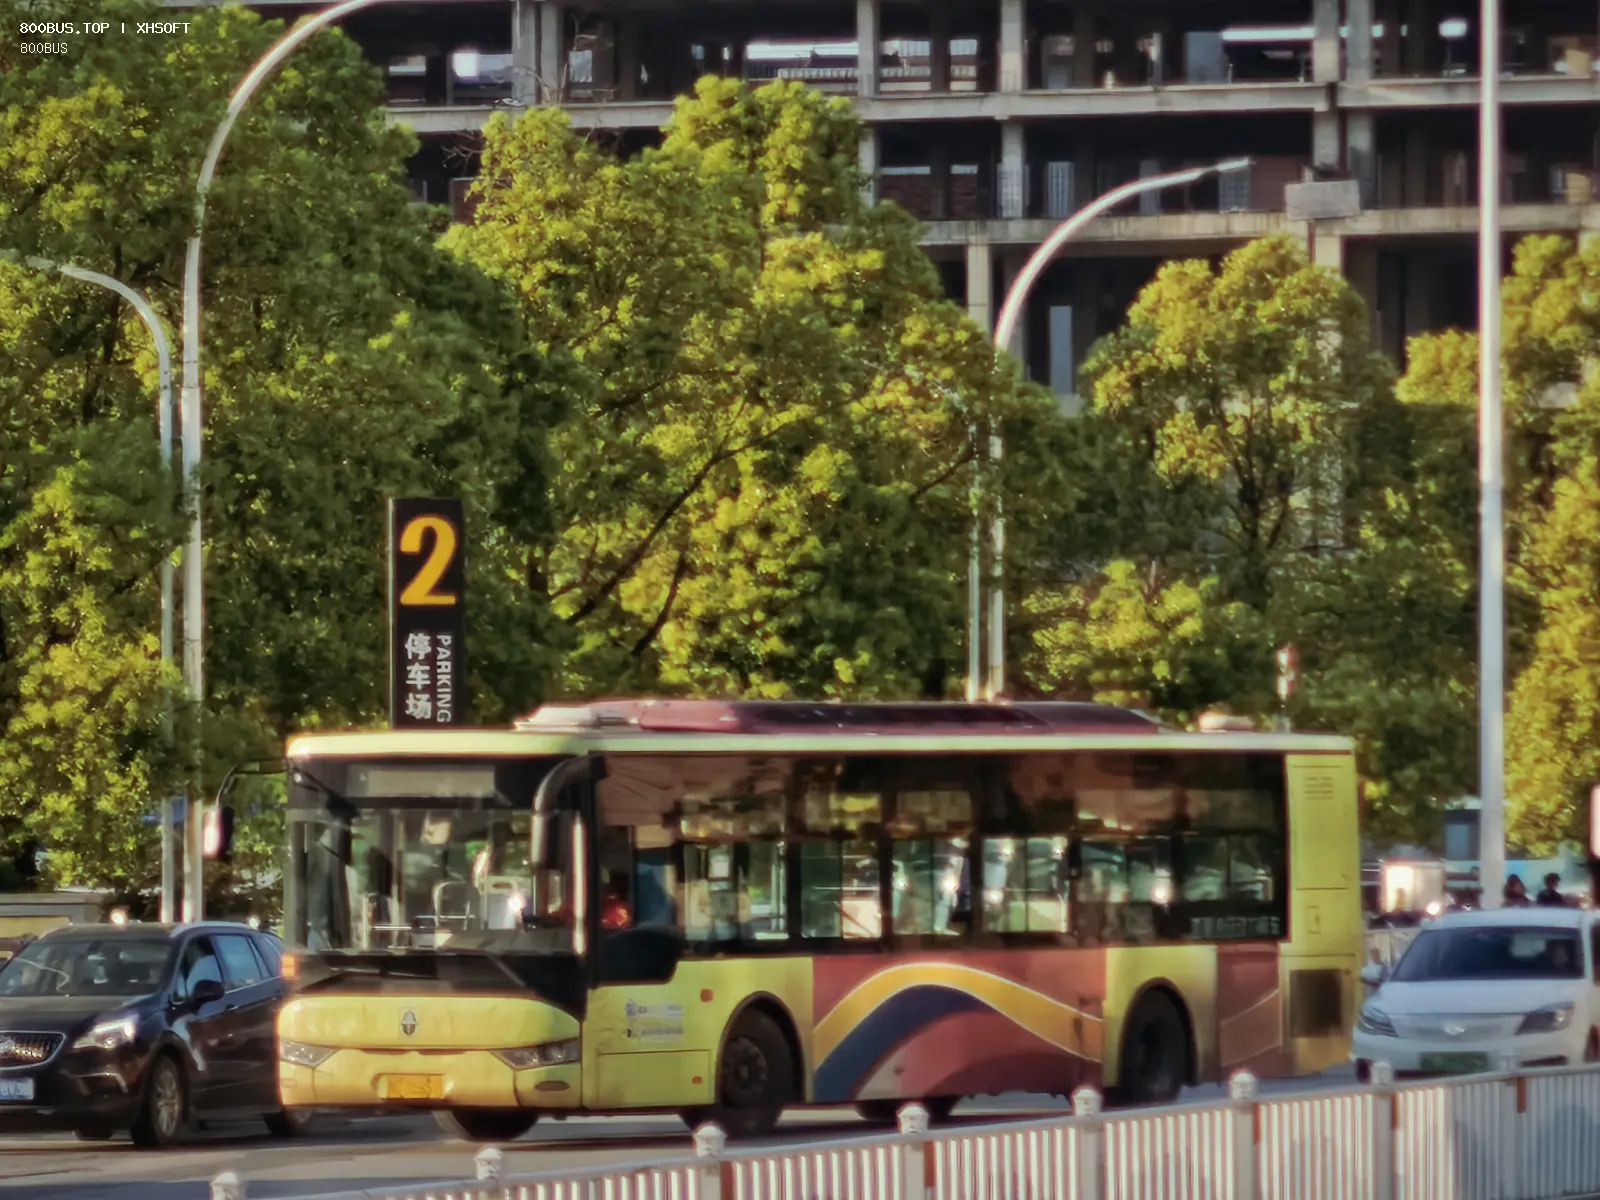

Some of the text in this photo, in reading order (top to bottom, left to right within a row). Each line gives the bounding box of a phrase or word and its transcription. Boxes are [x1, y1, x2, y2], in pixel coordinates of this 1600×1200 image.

[400, 517, 456, 605] 2
[405, 632, 432, 719] 停车场
[436, 634, 452, 723] PARKING
